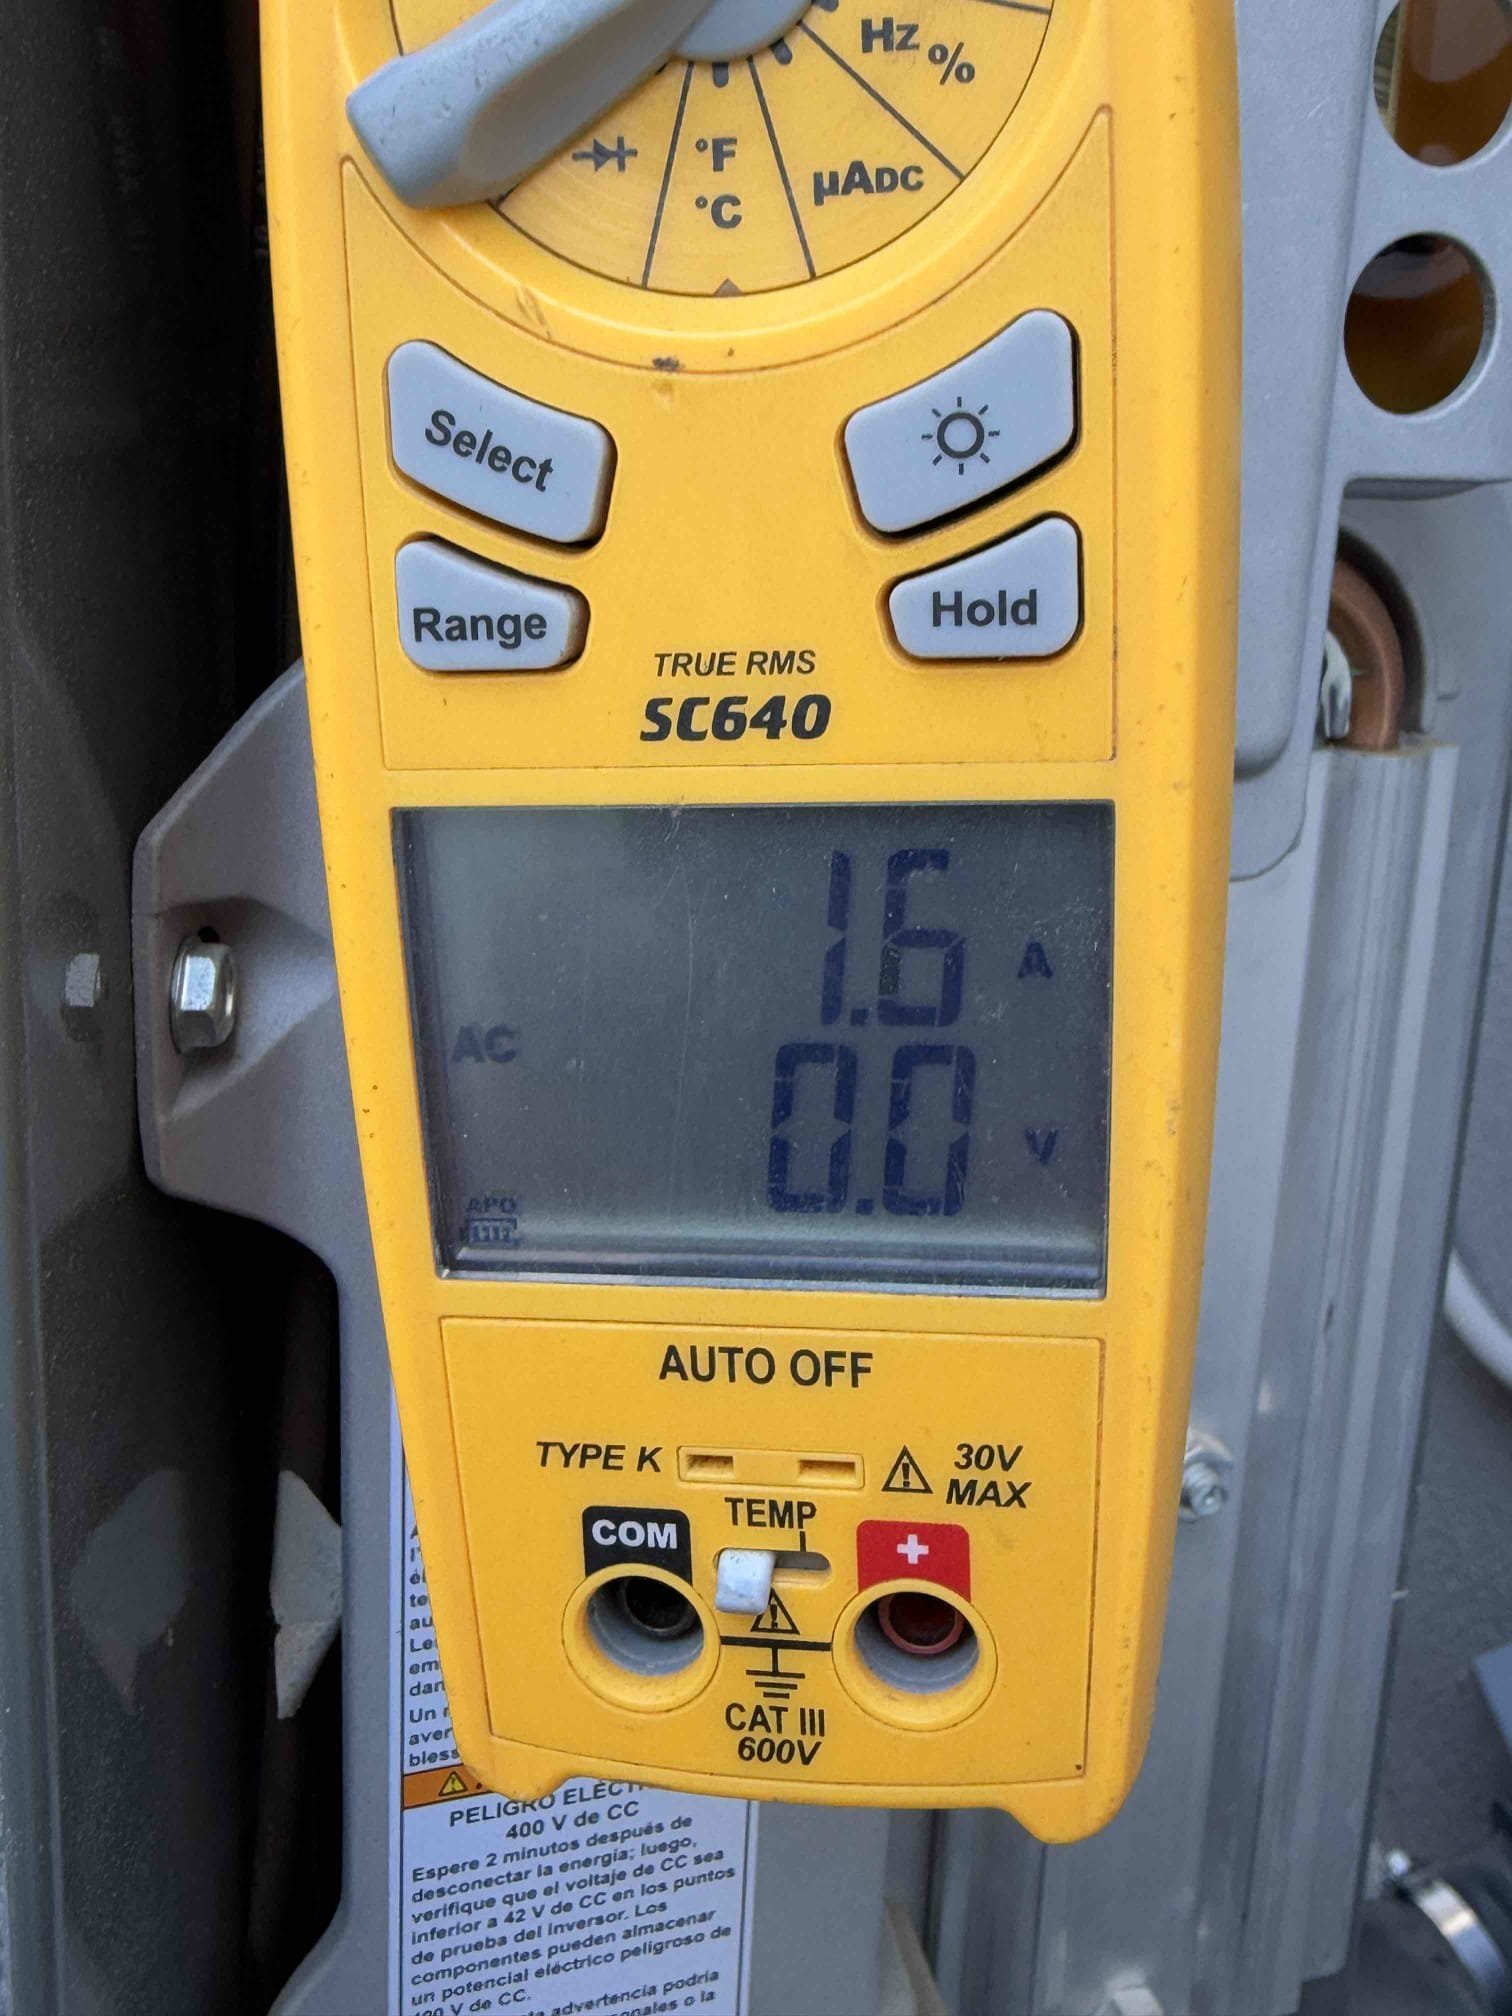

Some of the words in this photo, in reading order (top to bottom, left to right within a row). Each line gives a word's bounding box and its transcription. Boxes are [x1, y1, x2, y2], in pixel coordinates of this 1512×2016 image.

[861, 17, 920, 53] Hz
[424, 409, 554, 493] Select
[412, 606, 548, 650] Range
[931, 589, 1039, 629] Hold
[653, 652, 737, 678] TRUE
[745, 649, 816, 676] RMS
[639, 693, 832, 742] SC640
[820, 848, 966, 1029] 1.6
[1016, 941, 1054, 980] A
[451, 1024, 520, 1064] AC
[765, 1041, 977, 1216] 0.0
[658, 1345, 777, 1385] AUTO
[789, 1350, 875, 1389] OFF
[535, 1441, 626, 1471] TYPE
[636, 1446, 663, 1474] K
[953, 1442, 1023, 1472] 30V
[945, 1478, 1032, 1509] MAX
[724, 1497, 817, 1530] TEMP
[590, 1518, 679, 1550] COM
[409, 1707, 437, 1723] Un
[725, 1702, 790, 1735] CAT
[799, 1707, 826, 1738] III
[736, 1735, 823, 1766] 600V
[449, 1793, 556, 1827] PELIGRO
[505, 1818, 545, 1839] 400
[552, 1813, 568, 1831] V
[574, 1810, 600, 1828] de
[607, 1800, 640, 1821] CC
[412, 1859, 480, 1883] Espere
[486, 1852, 498, 1868] 2
[502, 1839, 580, 1865] minutos
[670, 1815, 693, 1831] de
[411, 1897, 497, 1924] verifique
[502, 1888, 538, 1907] que
[543, 1881, 560, 1898] el
[565, 1868, 627, 1892] voltaje
[632, 1863, 655, 1878] de
[660, 1854, 688, 1872] CC
[693, 1849, 725, 1866] sea
[412, 1868, 532, 1904] desconectar
[537, 1863, 553, 1878] la
[411, 1920, 482, 1945] inferior
[487, 1917, 498, 1930] a
[504, 1908, 526, 1924] 42
[532, 1903, 545, 1919] V
[550, 1901, 573, 1915] de
[579, 1891, 607, 1909] CC
[612, 1888, 635, 1903] en
[641, 1881, 669, 1897] los
[674, 1866, 737, 1892] puntos
[411, 1950, 434, 1965] de
[441, 1936, 508, 1962] prueba
[513, 1925, 543, 1944] del
[634, 1901, 668, 1918] Los
[411, 1948, 542, 1986] componentes
[547, 1931, 617, 1959] pueden
[622, 1909, 717, 1940] almacenar
[411, 1991, 435, 2007] un
[442, 1969, 530, 2003] potencial
[620, 1931, 705, 1963] peligroso
[710, 1925, 732, 1940] de
[469, 1999, 493, 2013] de
[551, 1984, 657, 2016] advertencia
[700, 1990, 716, 2004] la
